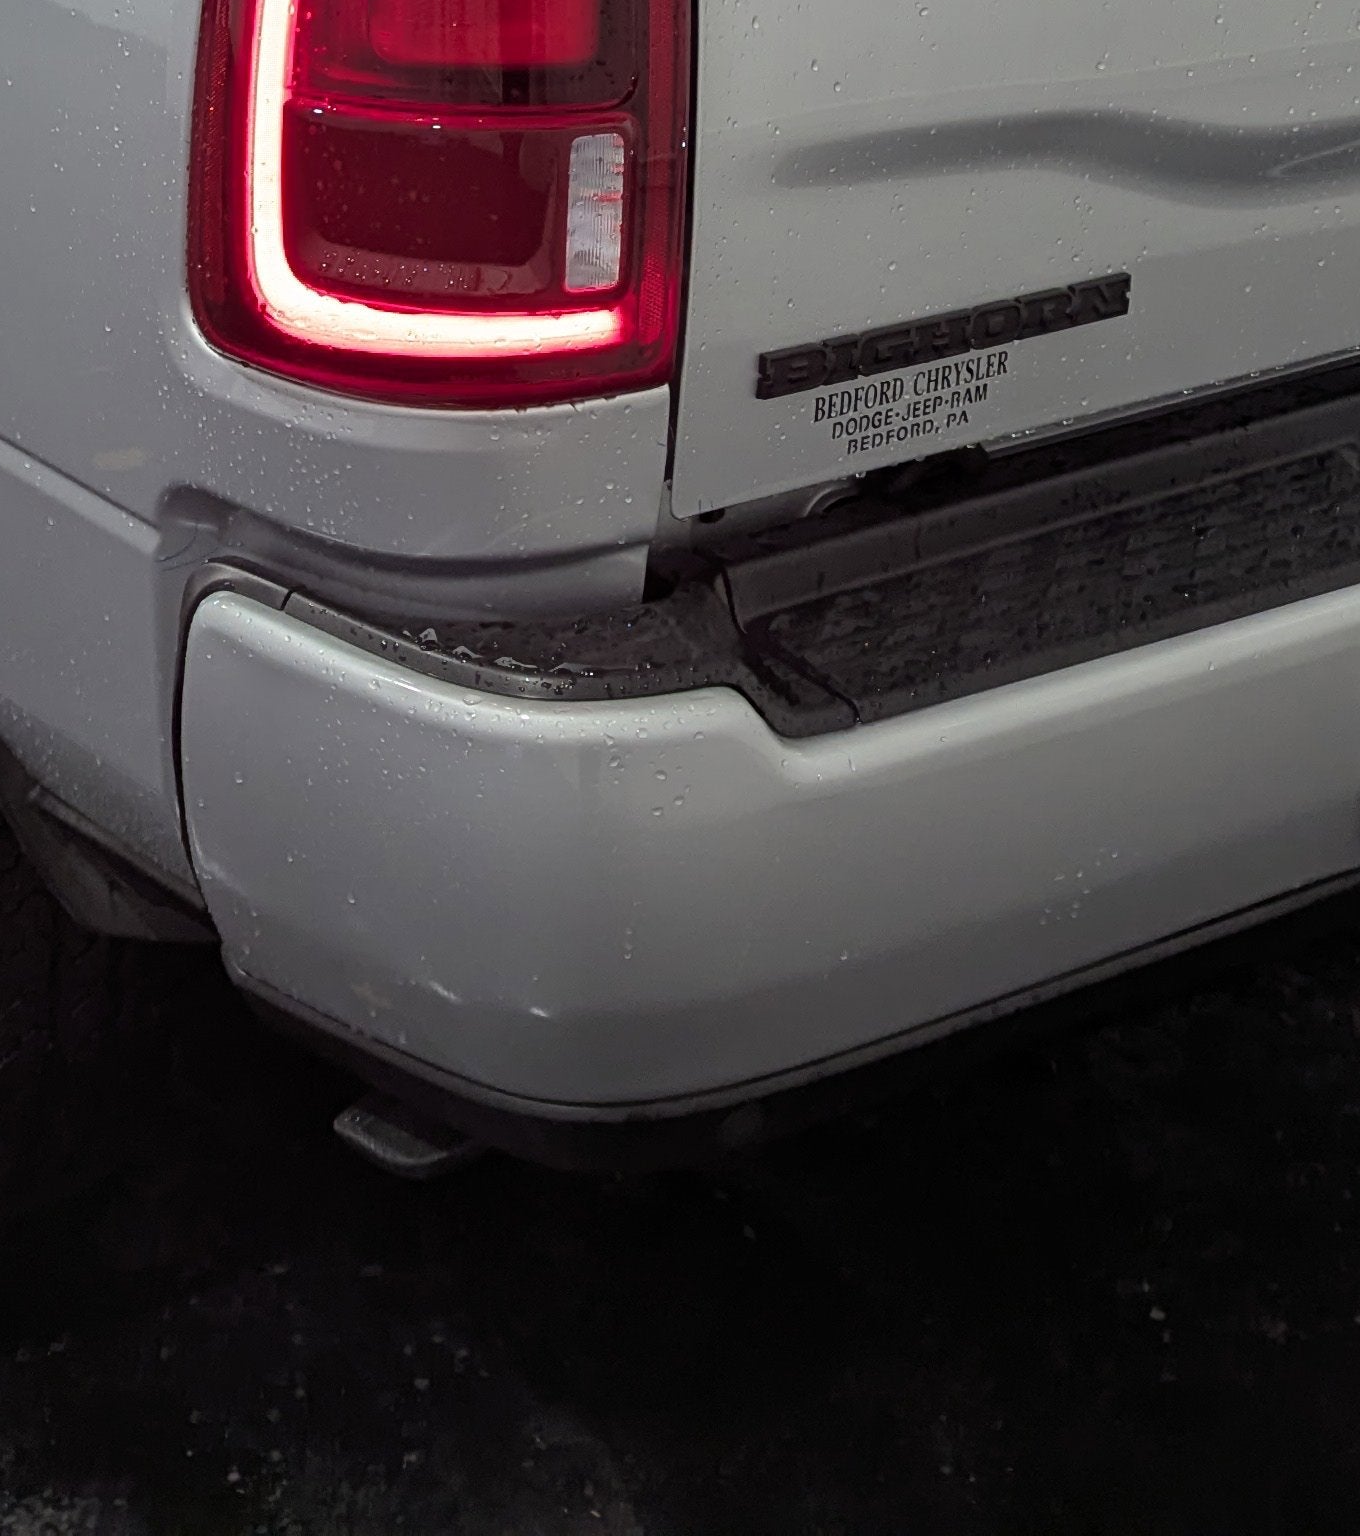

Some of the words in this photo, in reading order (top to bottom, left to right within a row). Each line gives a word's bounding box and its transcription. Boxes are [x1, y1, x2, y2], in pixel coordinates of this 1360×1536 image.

[812, 376, 905, 423] BEDFORD
[912, 350, 1010, 397] CHRYSLER
[946, 410, 970, 429] PA
